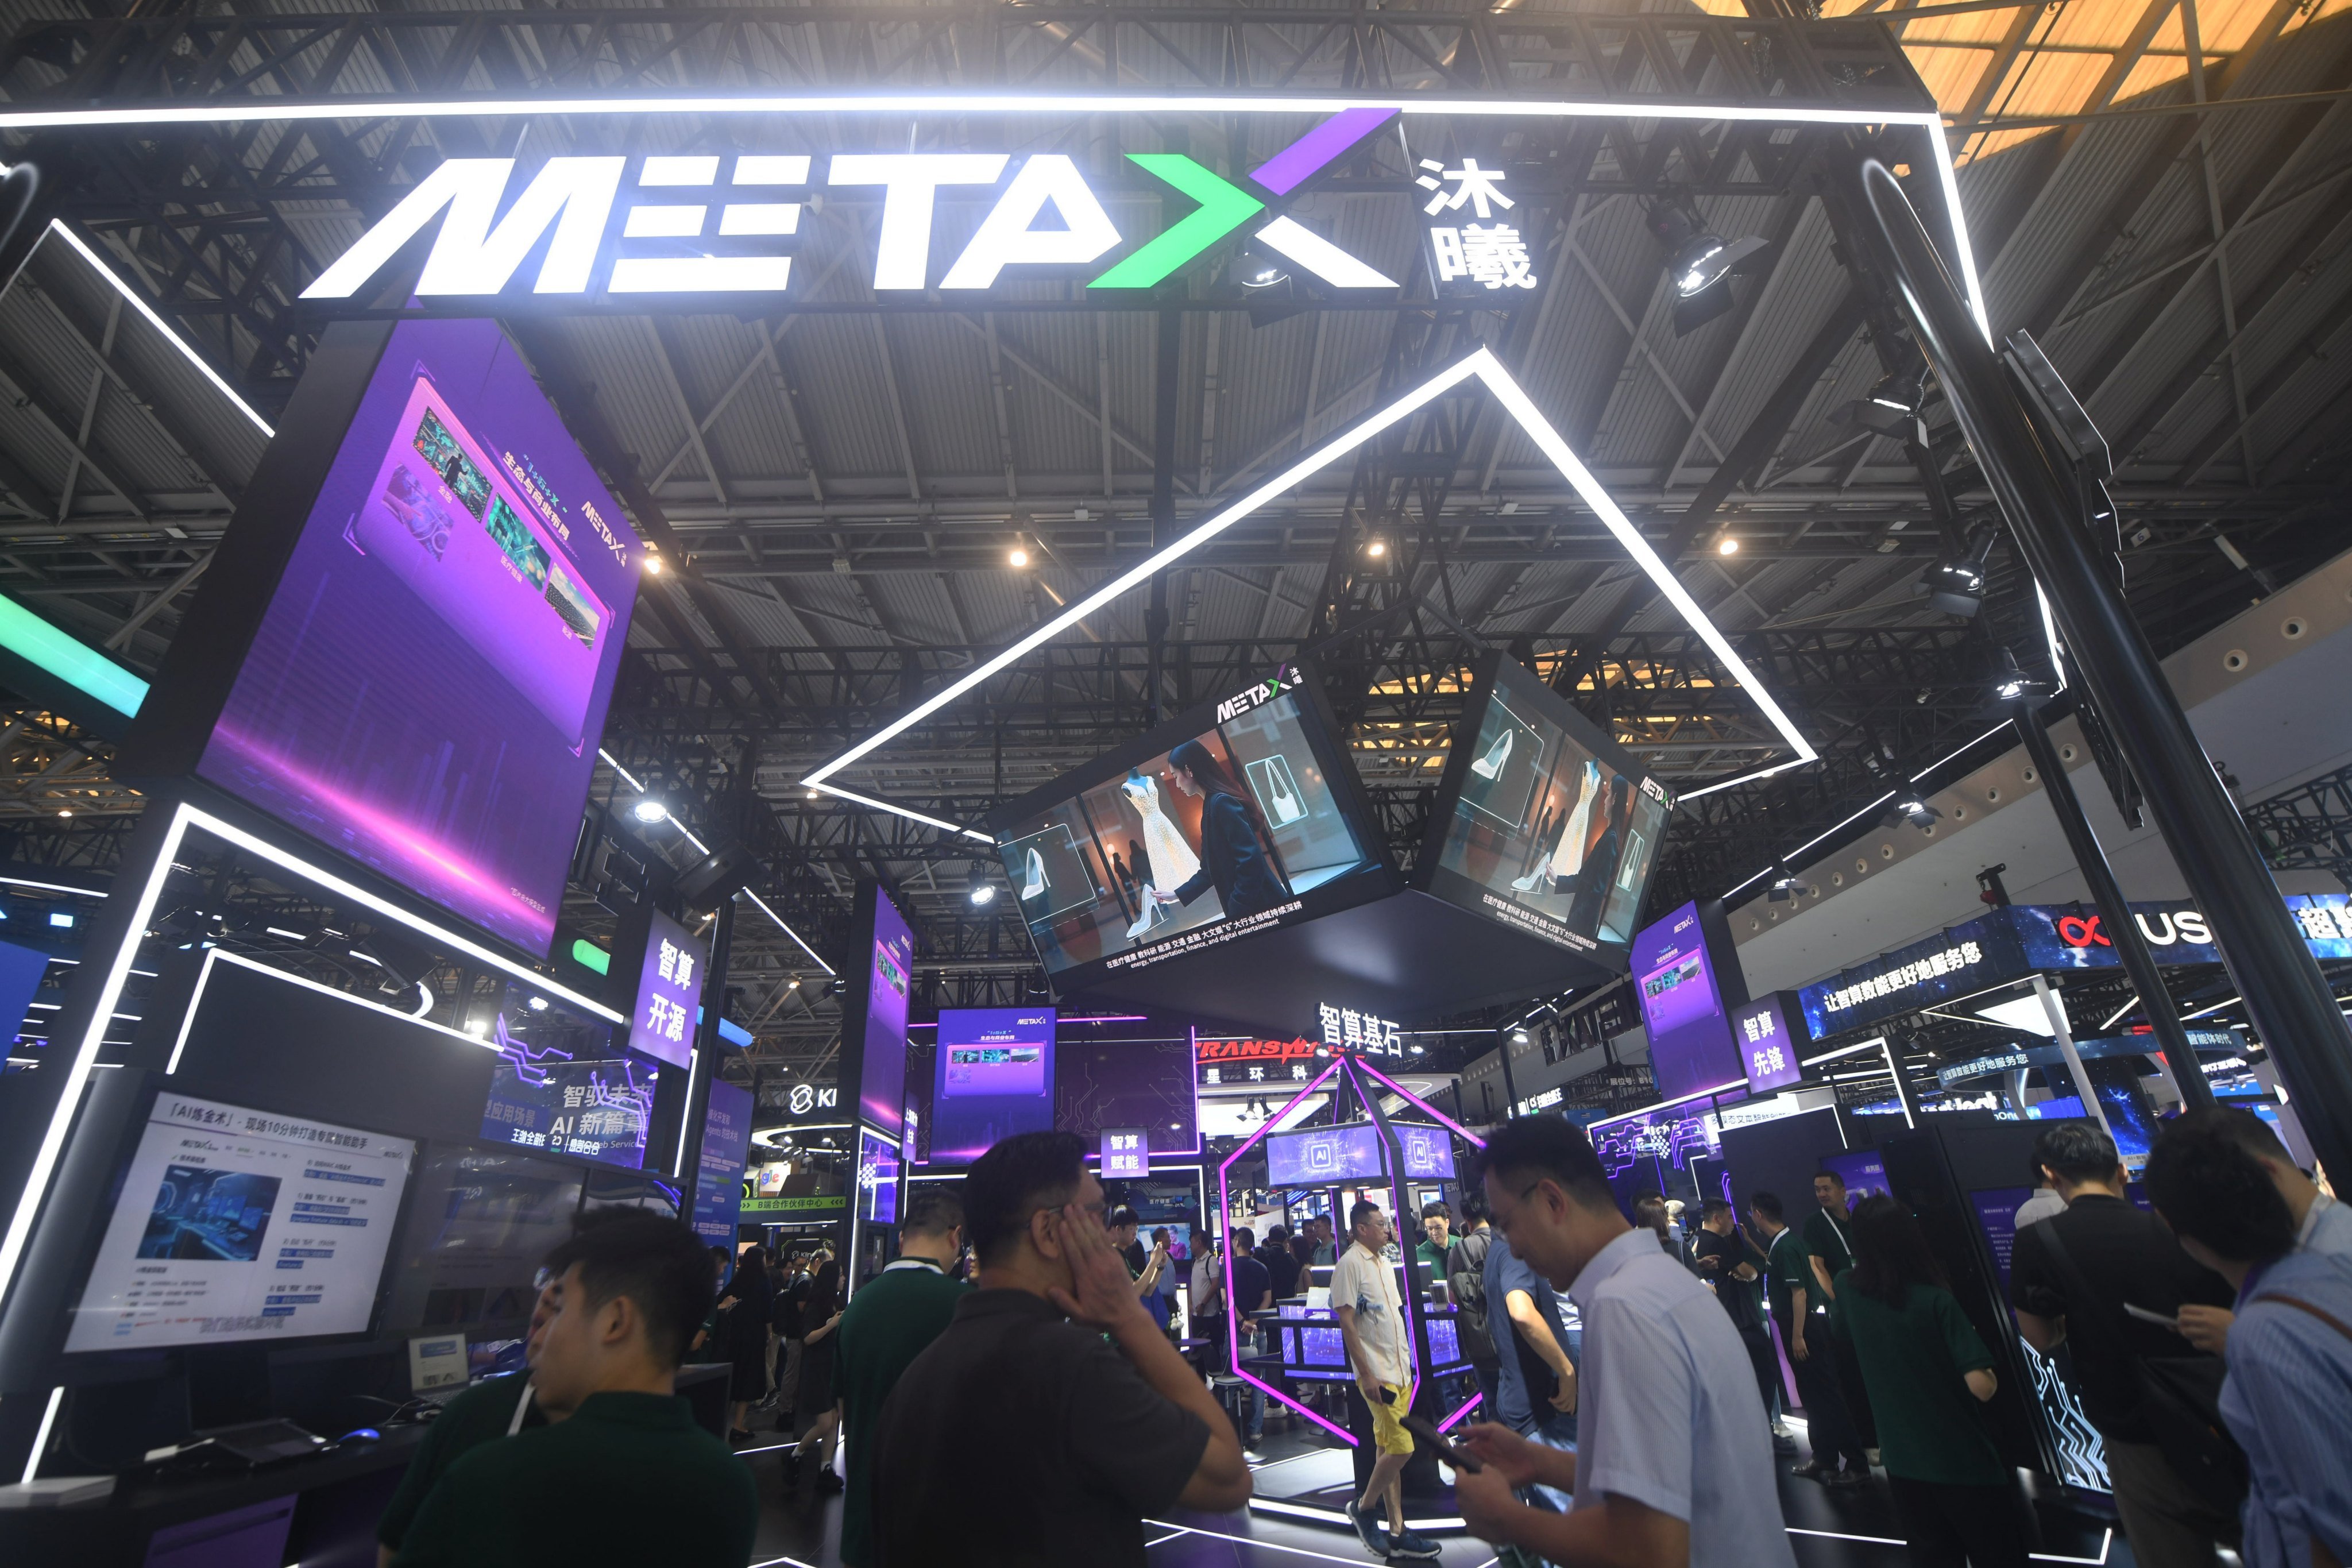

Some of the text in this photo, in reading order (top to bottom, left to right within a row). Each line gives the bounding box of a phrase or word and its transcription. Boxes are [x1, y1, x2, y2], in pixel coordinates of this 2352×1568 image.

[298, 107, 1401, 300] METAX
[1415, 158, 1537, 289] 沐曦
[438, 485, 453, 504] 金融
[503, 451, 570, 541] 生态与商业布局
[581, 501, 625, 561] METAX
[1289, 667, 1303, 685] 沐曦
[1217, 663, 1293, 724] METAX
[1640, 776, 1674, 809] METAX
[1482, 894, 1506, 910] 在医疗健康
[1506, 904, 1520, 916] 教科研
[1520, 910, 1530, 920] 能源
[1530, 914, 1539, 924] 交通
[1131, 918, 1280, 968] energy, transportation, finance, and digital entertainment
[1497, 910, 1509, 922] energy,
[1509, 916, 1534, 932] transportation,
[1534, 926, 1546, 937] finance,
[1552, 933, 1563, 943] digital
[1563, 937, 1583, 952] entertainment
[658, 938, 694, 991] 智算
[1106, 953, 1137, 968] 在医疗健康
[1137, 947, 1157, 959] 教科研
[1157, 942, 1172, 953] 能源
[1172, 937, 1186, 949] 交通
[1186, 933, 1202, 944] 金融
[1824, 941, 1982, 1013] 让智算数能更好地服务您
[647, 992, 686, 1042] 开源
[1017, 1016, 1044, 1025] METAX
[1319, 1002, 1402, 1058] 智算基石
[1743, 1011, 1775, 1043] 智算
[1754, 1045, 1786, 1077] 先锋
[550, 1111, 649, 1136] AI 新篇章
[1110, 1134, 1138, 1150] 智算
[1316, 1150, 1327, 1161] AI
[1416, 1146, 1424, 1157] AI
[1110, 1154, 1139, 1170] 赋能
[758, 1198, 822, 1209] B端合作伙伴中心
